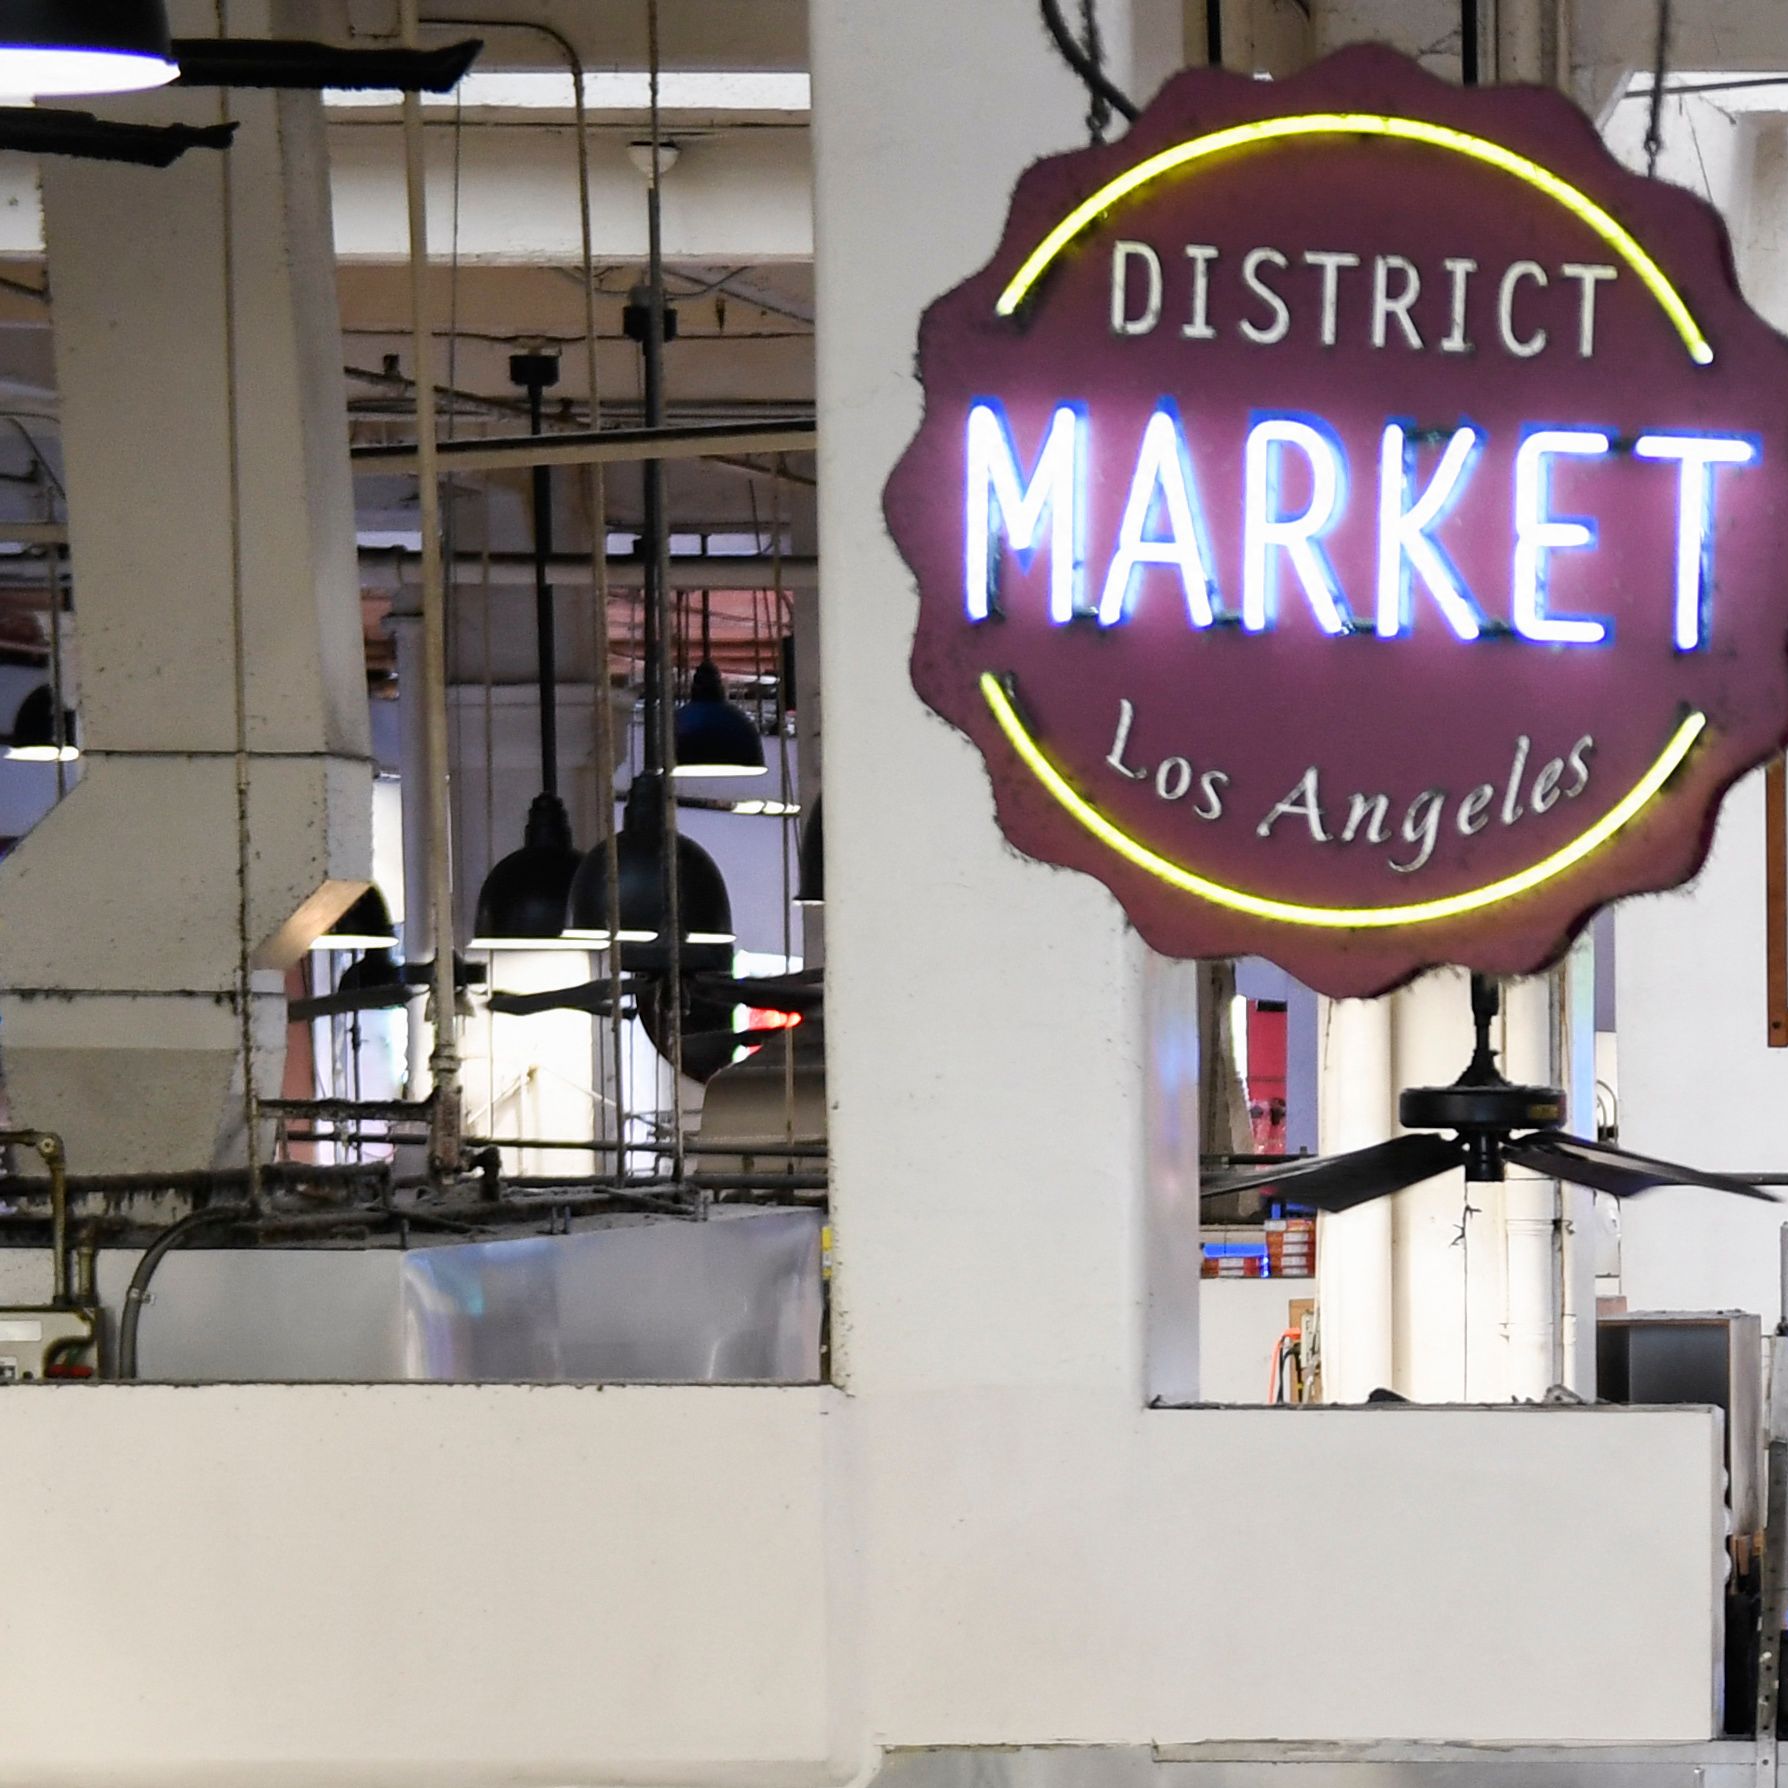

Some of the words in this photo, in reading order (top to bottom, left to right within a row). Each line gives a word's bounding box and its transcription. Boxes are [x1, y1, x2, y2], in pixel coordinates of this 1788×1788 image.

[1109, 240, 1619, 358] DISTRICT
[963, 398, 1757, 650] MARKET
[1106, 699, 1229, 820] Los
[1257, 733, 1594, 872] Angeles
